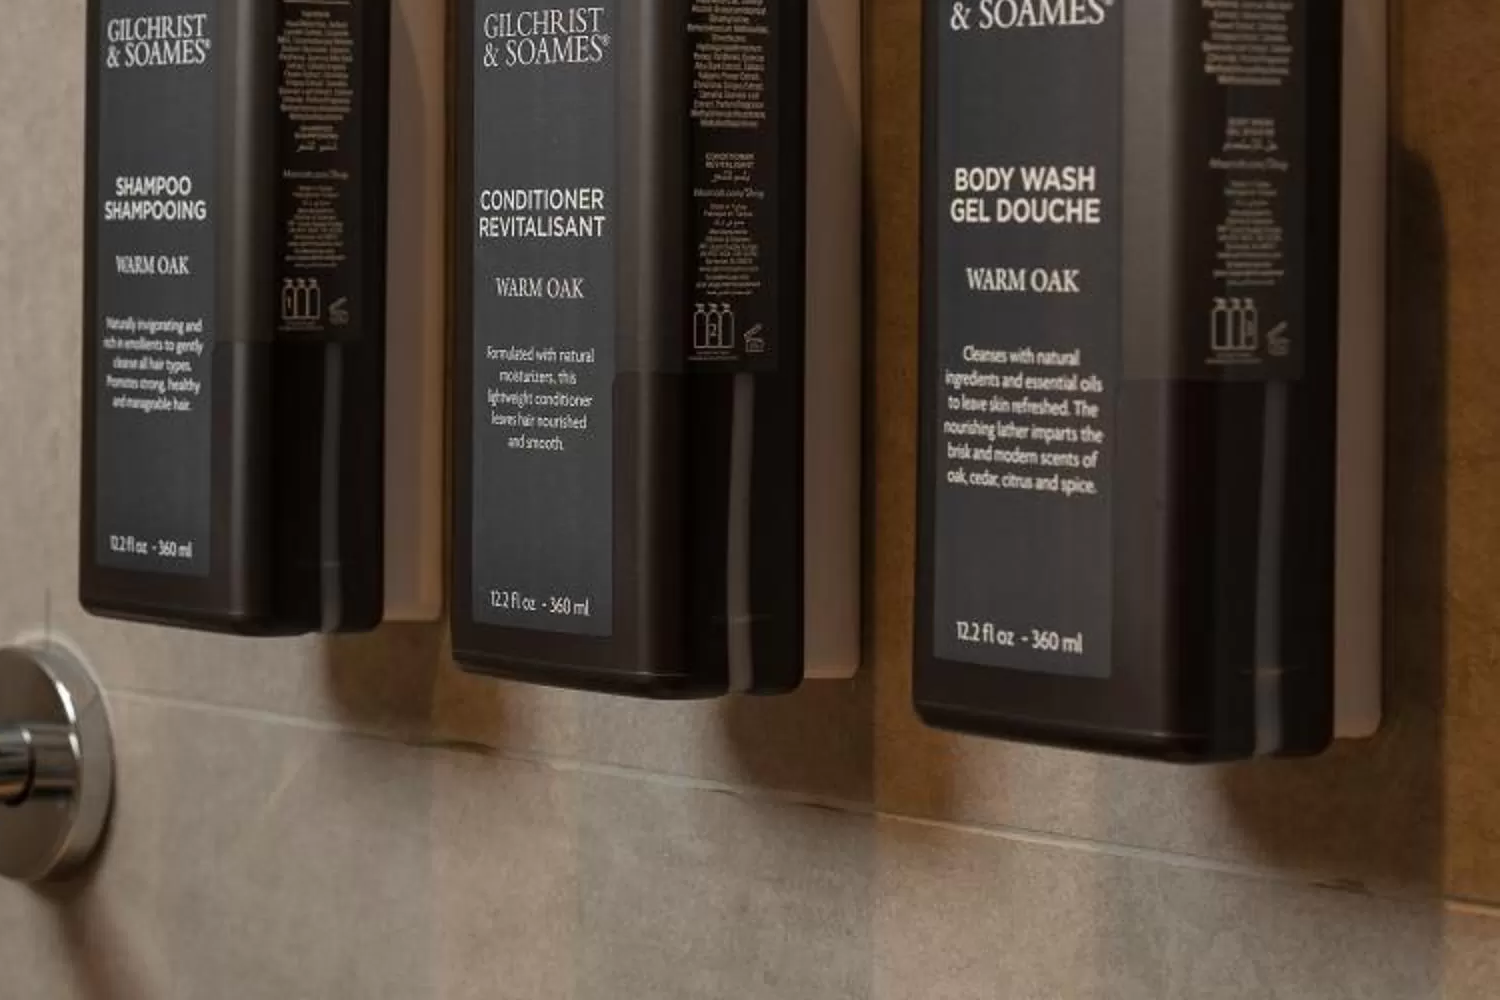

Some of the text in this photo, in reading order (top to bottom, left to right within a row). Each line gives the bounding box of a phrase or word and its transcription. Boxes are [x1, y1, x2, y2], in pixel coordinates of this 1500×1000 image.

[107, 13, 207, 42] GILCHRIST
[484, 7, 604, 37] GILCHRIST
[950, 2, 970, 31] &
[106, 44, 121, 68] &
[483, 43, 499, 67] &
[115, 175, 192, 196] SHAMPOO
[955, 166, 1096, 191] BODY WASH
[104, 199, 207, 221] SHAMPOOING
[480, 188, 604, 210] CONDITIONER
[950, 197, 1100, 223] GEL DOUCHE
[479, 216, 606, 238] REVITALISANT
[115, 255, 190, 275] WARM OAK
[495, 277, 584, 299] WARM OAK
[966, 267, 1080, 293] WARM OAK
[186, 318, 202, 333] and
[164, 339, 174, 351] to
[176, 338, 203, 357] gently
[486, 345, 595, 363] Formulated with natural
[964, 345, 1080, 366] Cleanses with natural
[168, 377, 200, 396] healthy
[558, 369, 576, 384] this
[945, 369, 1104, 392] ingredients and essential oils
[487, 388, 593, 408] lightweight conditioner
[948, 394, 1099, 418] to leave skin refreshed. The
[491, 410, 587, 429] leaves hair nourished
[508, 434, 525, 449] and
[944, 419, 1104, 445] nourishing lather imparts the
[948, 442, 1100, 468] brisk and modern scents of
[947, 467, 1098, 496] oak, cedar, citrus and spice.
[158, 539, 177, 557] 360
[178, 541, 192, 558] ml
[550, 596, 571, 615] 360
[573, 597, 590, 616] ml
[996, 630, 1015, 646] oz
[1031, 629, 1060, 650] 360
[1062, 632, 1083, 656] ml
